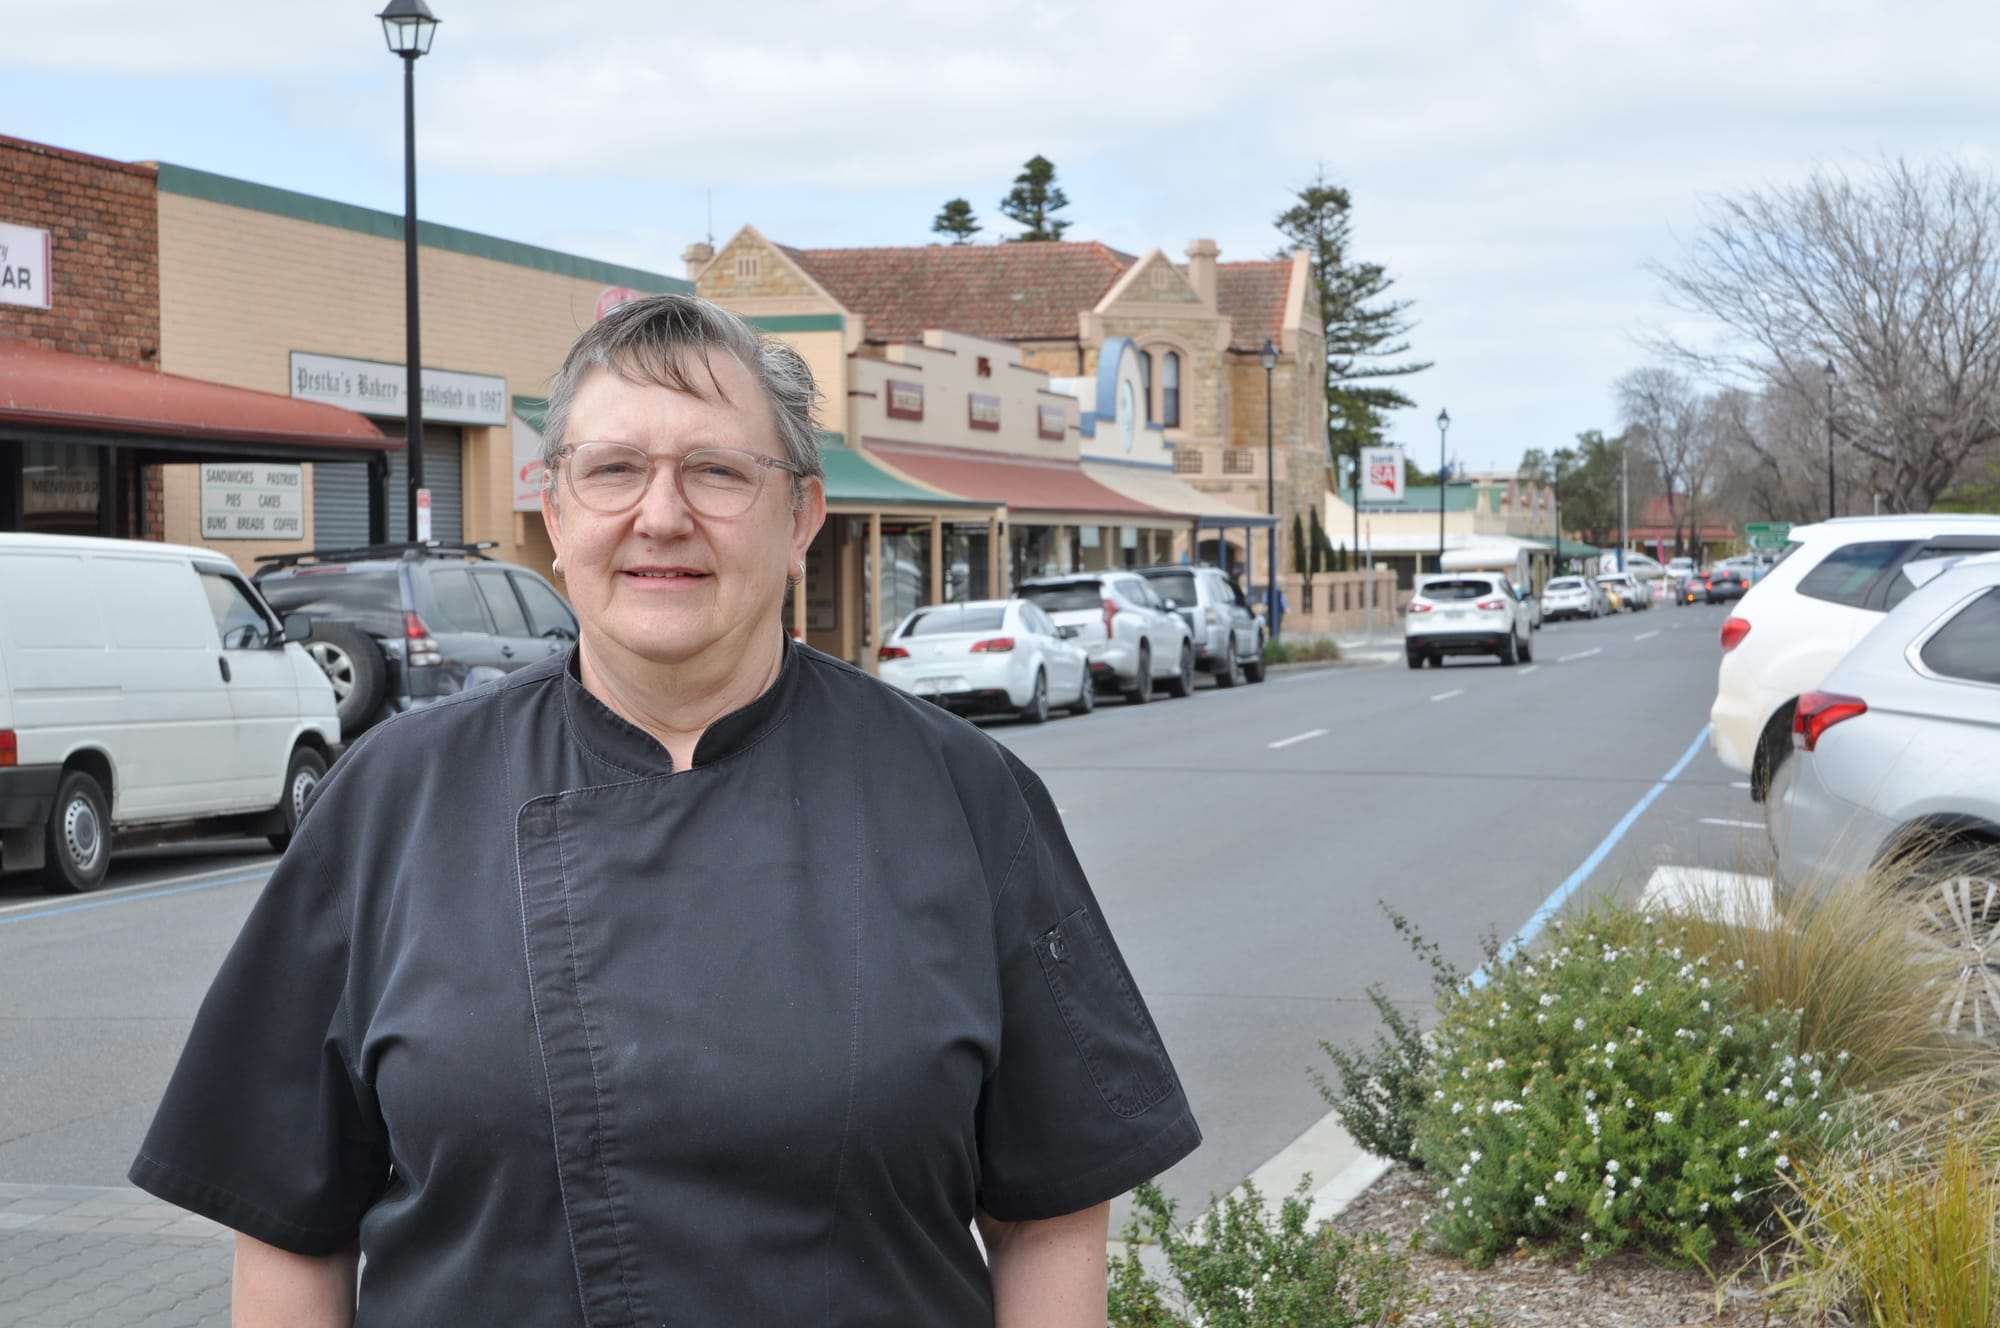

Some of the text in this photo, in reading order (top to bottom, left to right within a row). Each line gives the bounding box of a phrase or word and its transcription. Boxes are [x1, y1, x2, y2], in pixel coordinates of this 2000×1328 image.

[297, 366, 351, 394] Pestka's
[358, 373, 398, 398] Bakery
[207, 469, 298, 487] SANDWICHES PASTRIES
[1370, 464, 1396, 494] SA
[226, 493, 281, 509] PIES CAKES
[207, 516, 298, 532] BUNS BREADS COFFEE
